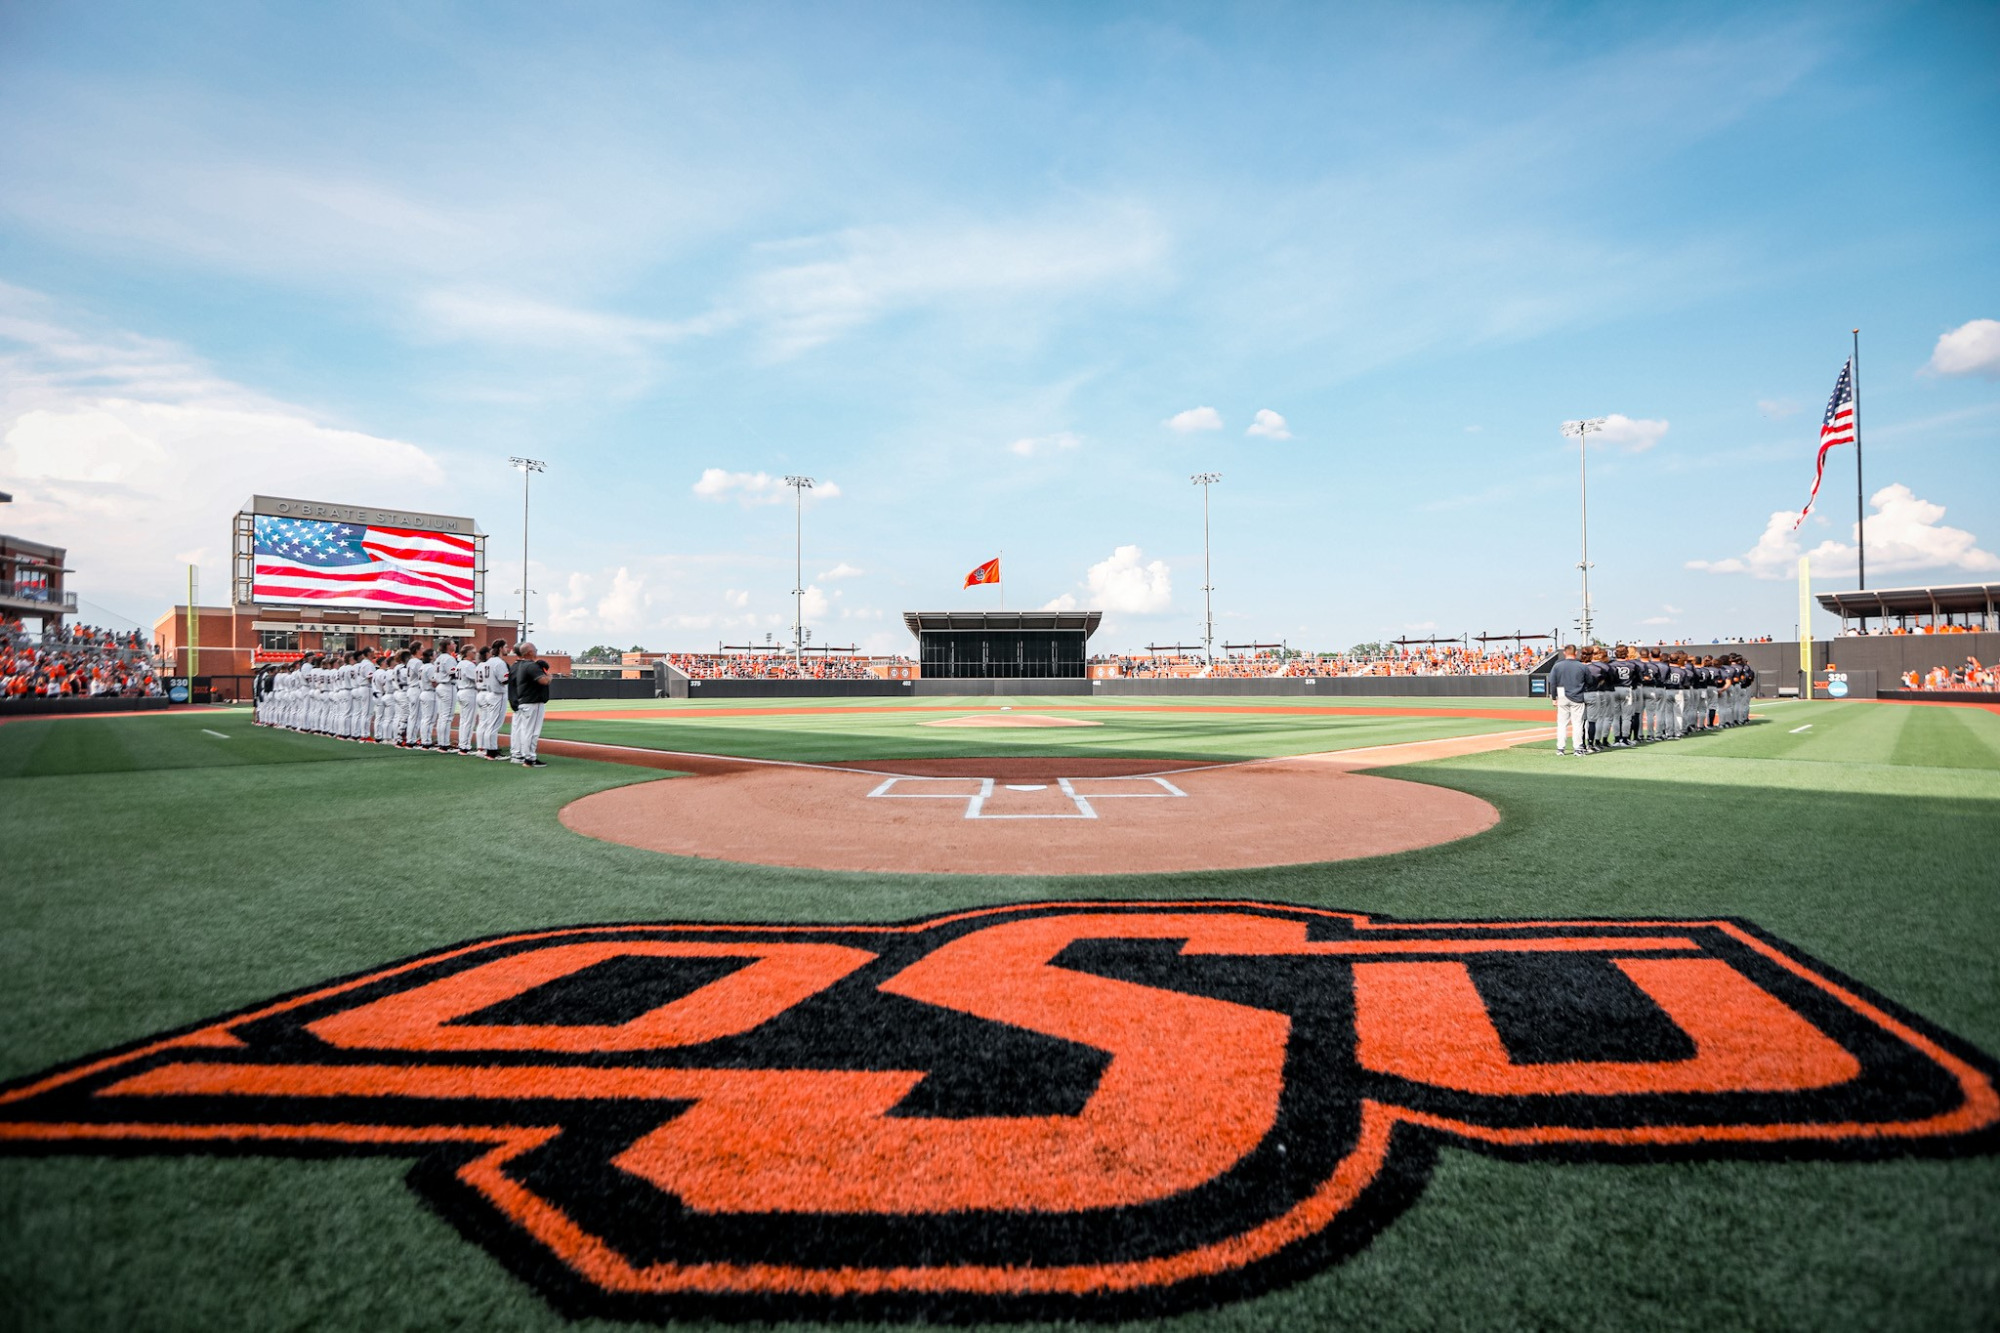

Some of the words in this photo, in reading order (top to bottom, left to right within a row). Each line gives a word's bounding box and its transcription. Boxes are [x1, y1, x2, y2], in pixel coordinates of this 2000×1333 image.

[276, 502, 366, 521] O'BRATE
[376, 513, 458, 529] STADIUM
[295, 623, 341, 633] MAKE
[352, 625, 366, 633] IT
[379, 627, 440, 635] HAPEN
[1616, 666, 1630, 680] 12
[1828, 673, 1848, 682] 320
[170, 678, 188, 686] 330
[0, 900, 2000, 1310] OSU
